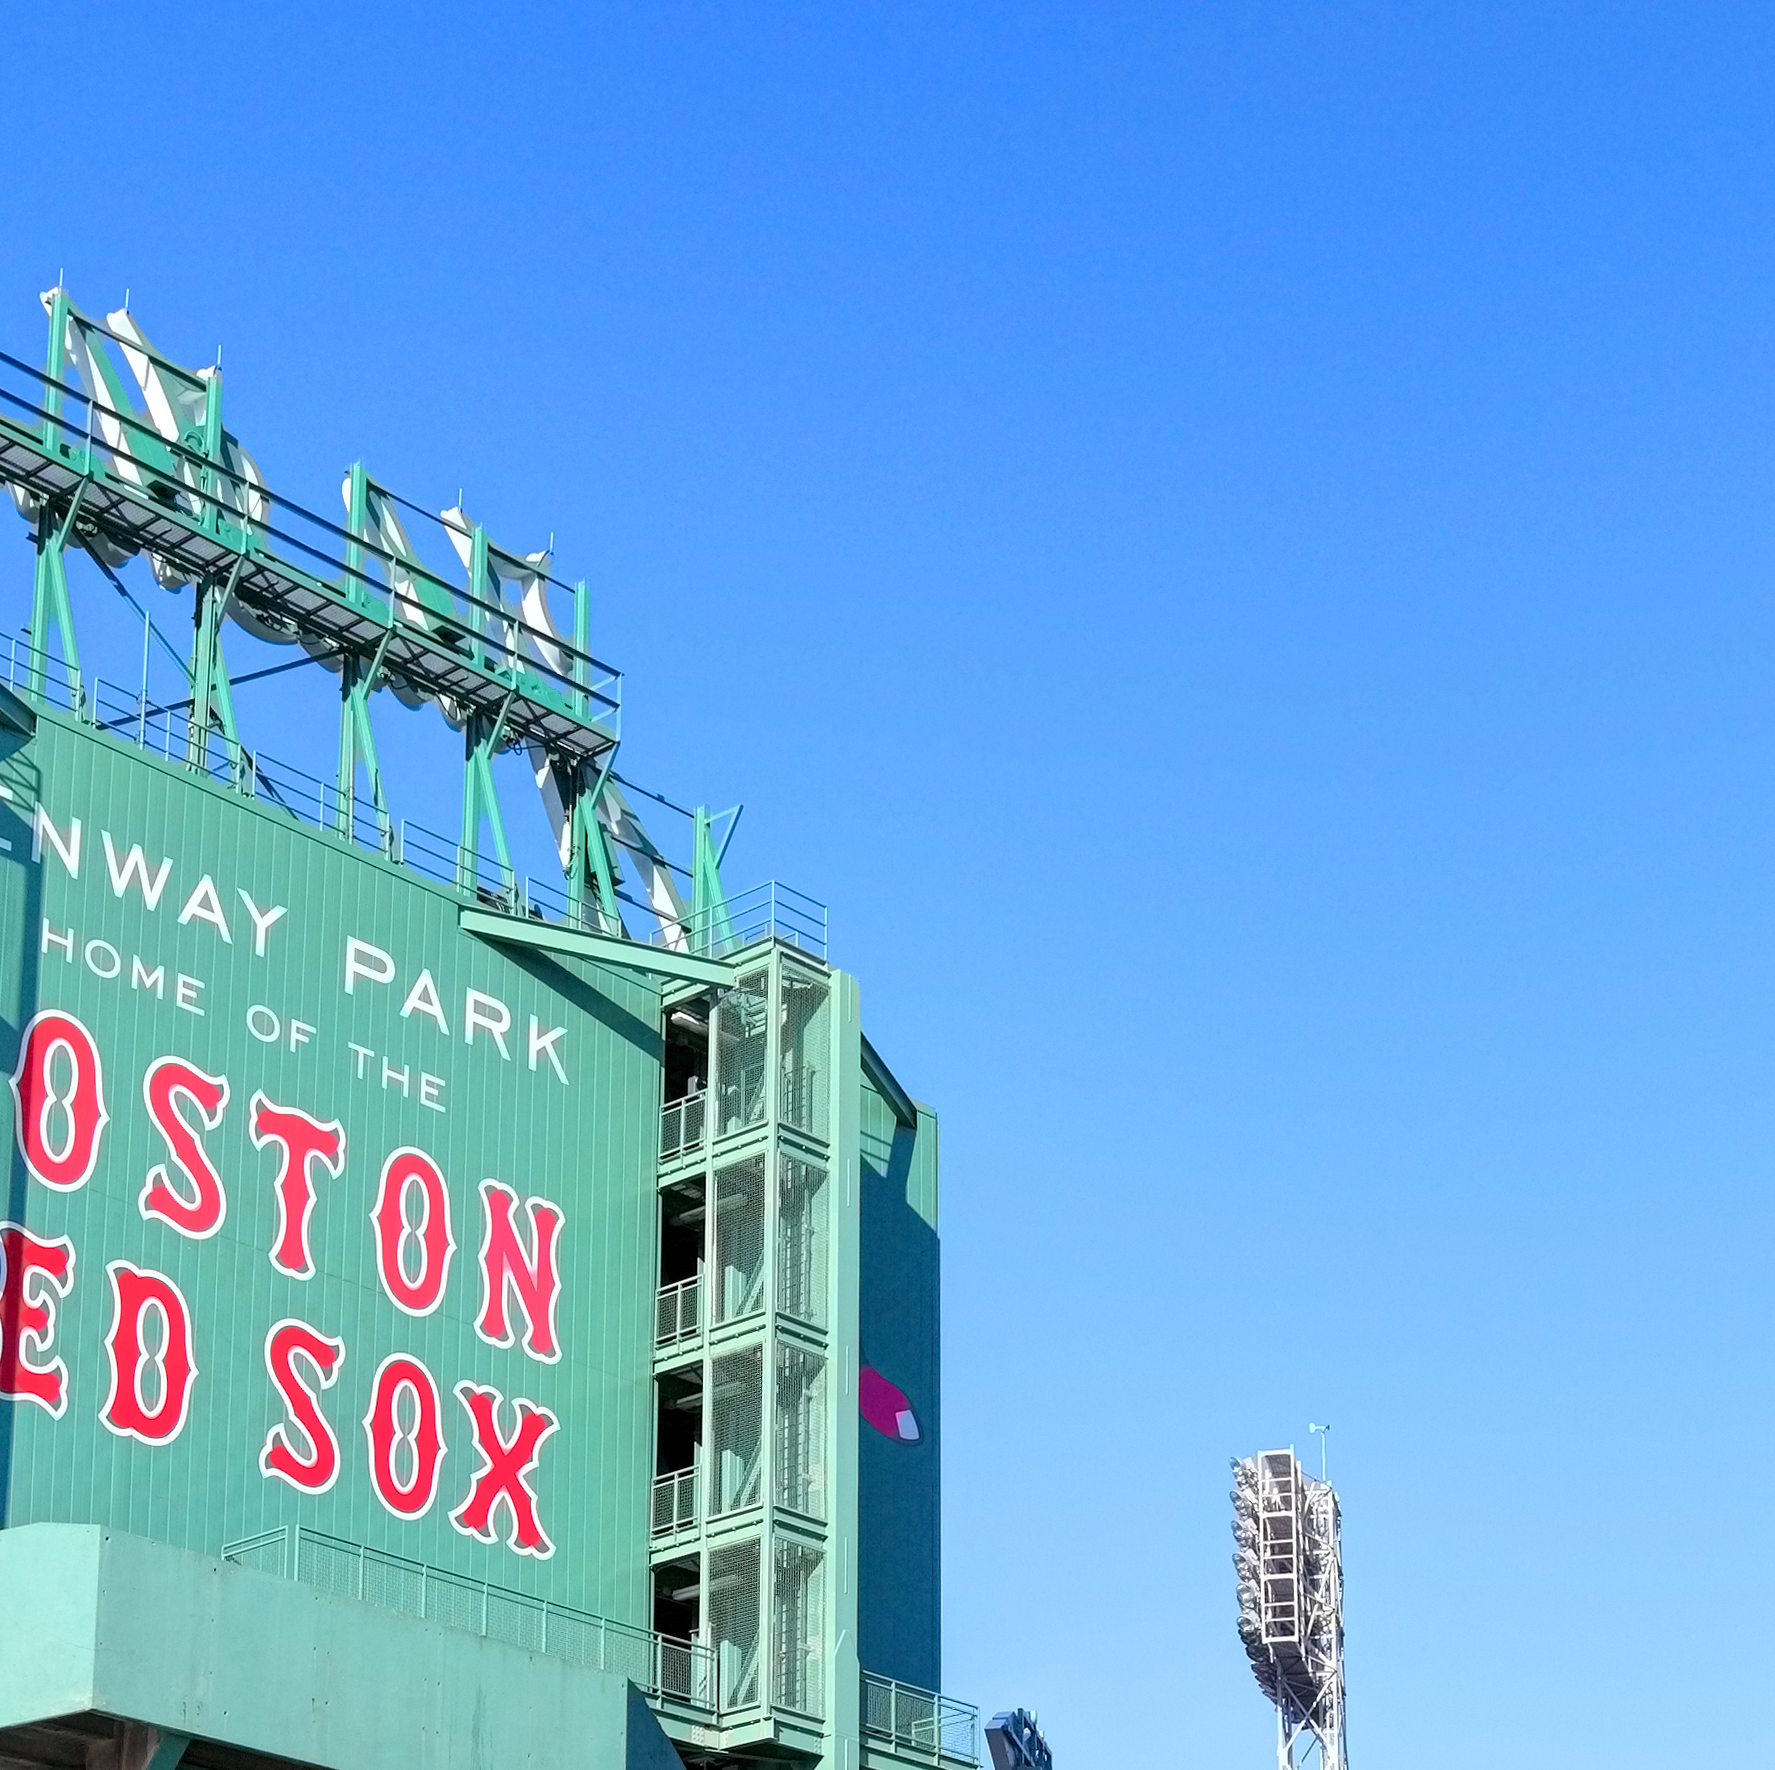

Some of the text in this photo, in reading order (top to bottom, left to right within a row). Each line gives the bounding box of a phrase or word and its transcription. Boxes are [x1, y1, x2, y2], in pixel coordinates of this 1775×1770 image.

[41, 921, 448, 1115] HOME OF THE
[344, 935, 570, 1086] PARK
[258, 1318, 560, 1560] SOX
